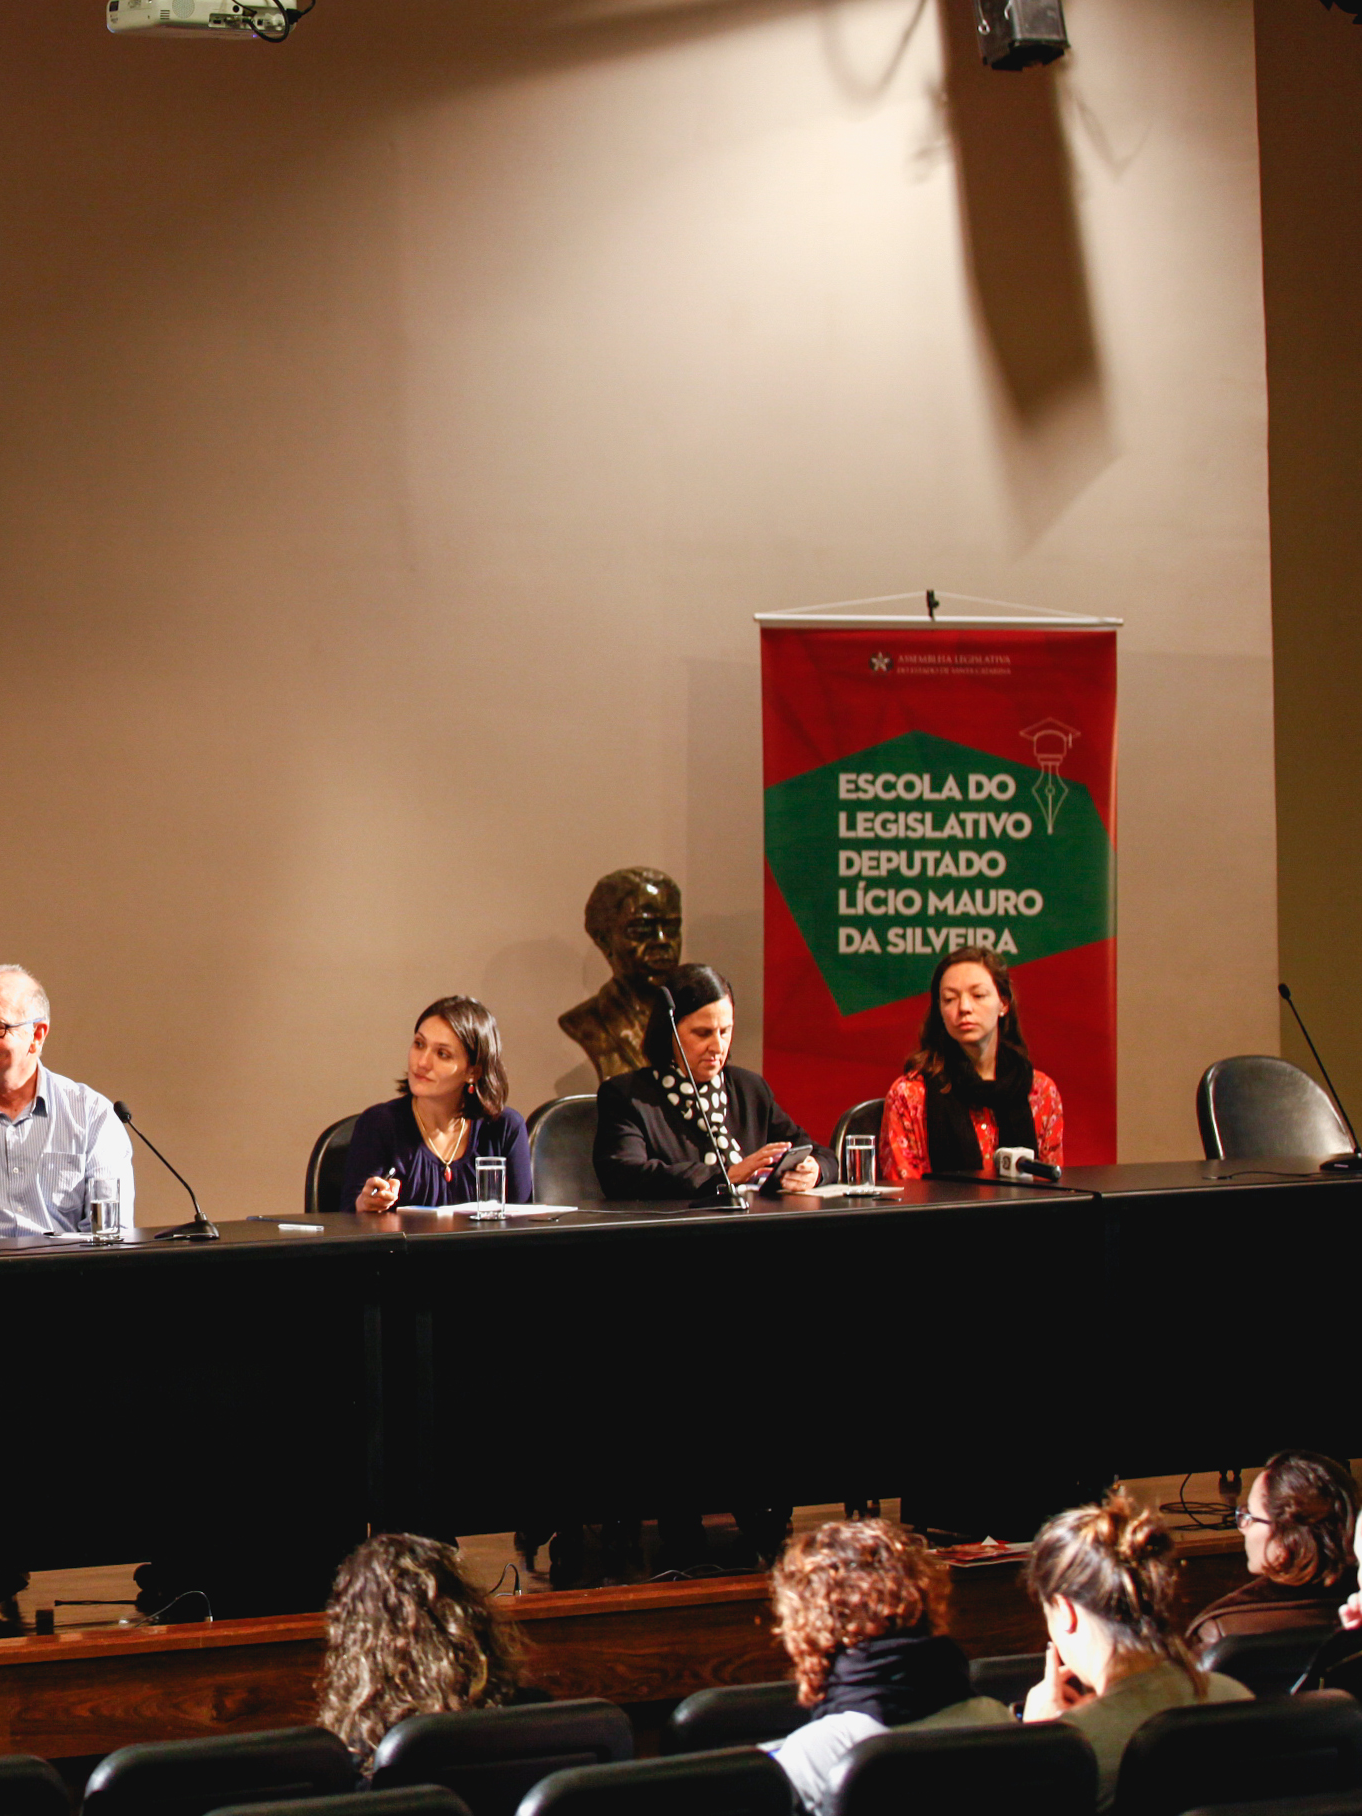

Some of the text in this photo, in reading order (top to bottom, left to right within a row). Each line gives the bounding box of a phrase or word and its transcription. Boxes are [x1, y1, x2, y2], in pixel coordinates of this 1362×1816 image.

[838, 773, 1017, 801] ESCOLA DO
[838, 811, 1033, 839] LEGISLATIVO
[838, 850, 1007, 878] DEPUTADO
[838, 880, 1045, 917] LÍCIO MAURO
[838, 926, 1019, 955] DA SILVEIRA
